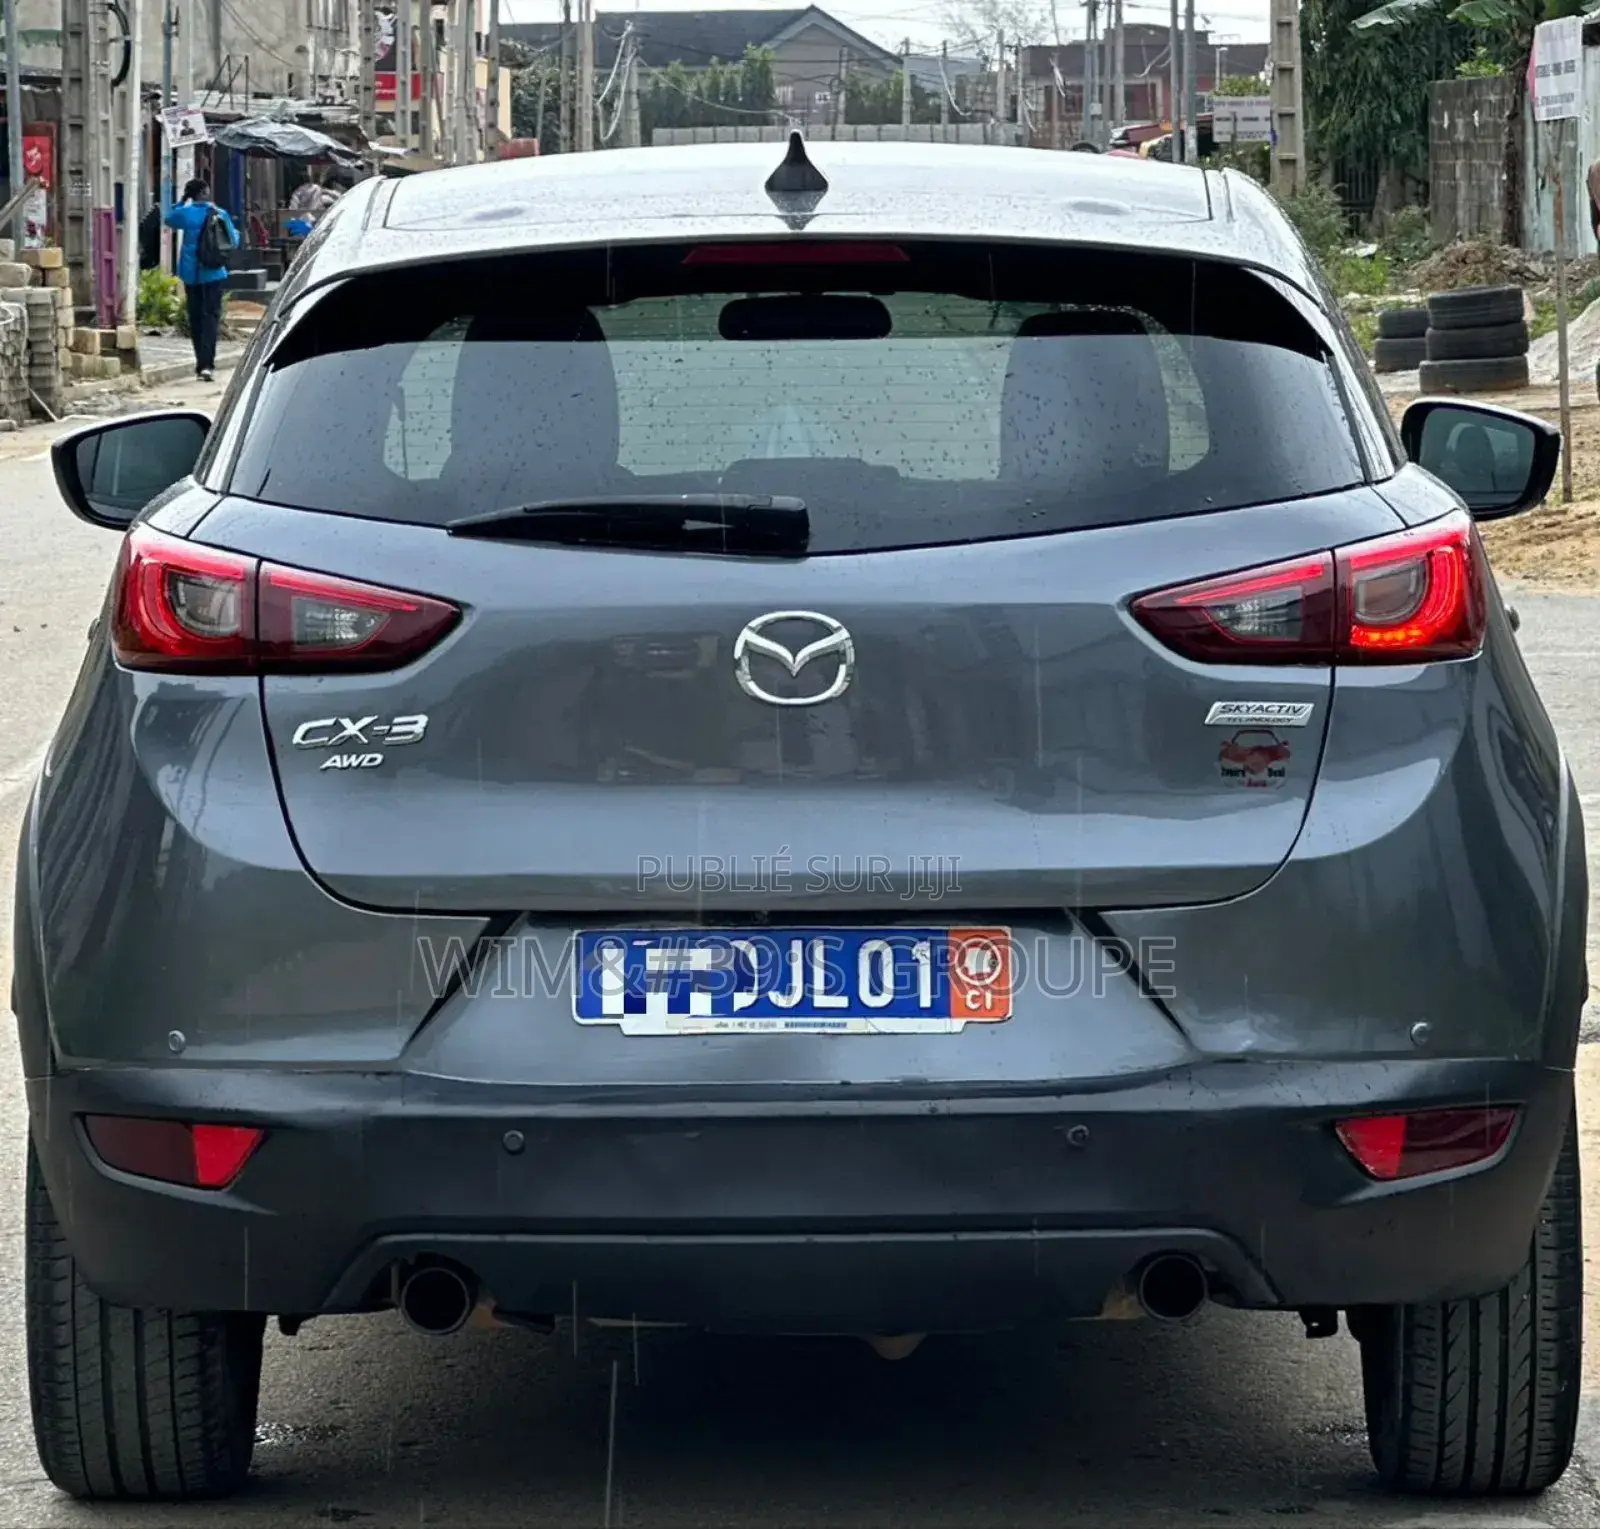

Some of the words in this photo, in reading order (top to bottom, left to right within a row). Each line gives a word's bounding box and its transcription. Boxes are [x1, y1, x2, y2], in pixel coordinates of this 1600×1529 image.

[1220, 704, 1304, 714] SKYACTIV
[292, 714, 429, 748] CX-3
[320, 753, 384, 770] AWD
[966, 989, 993, 1010] CI
